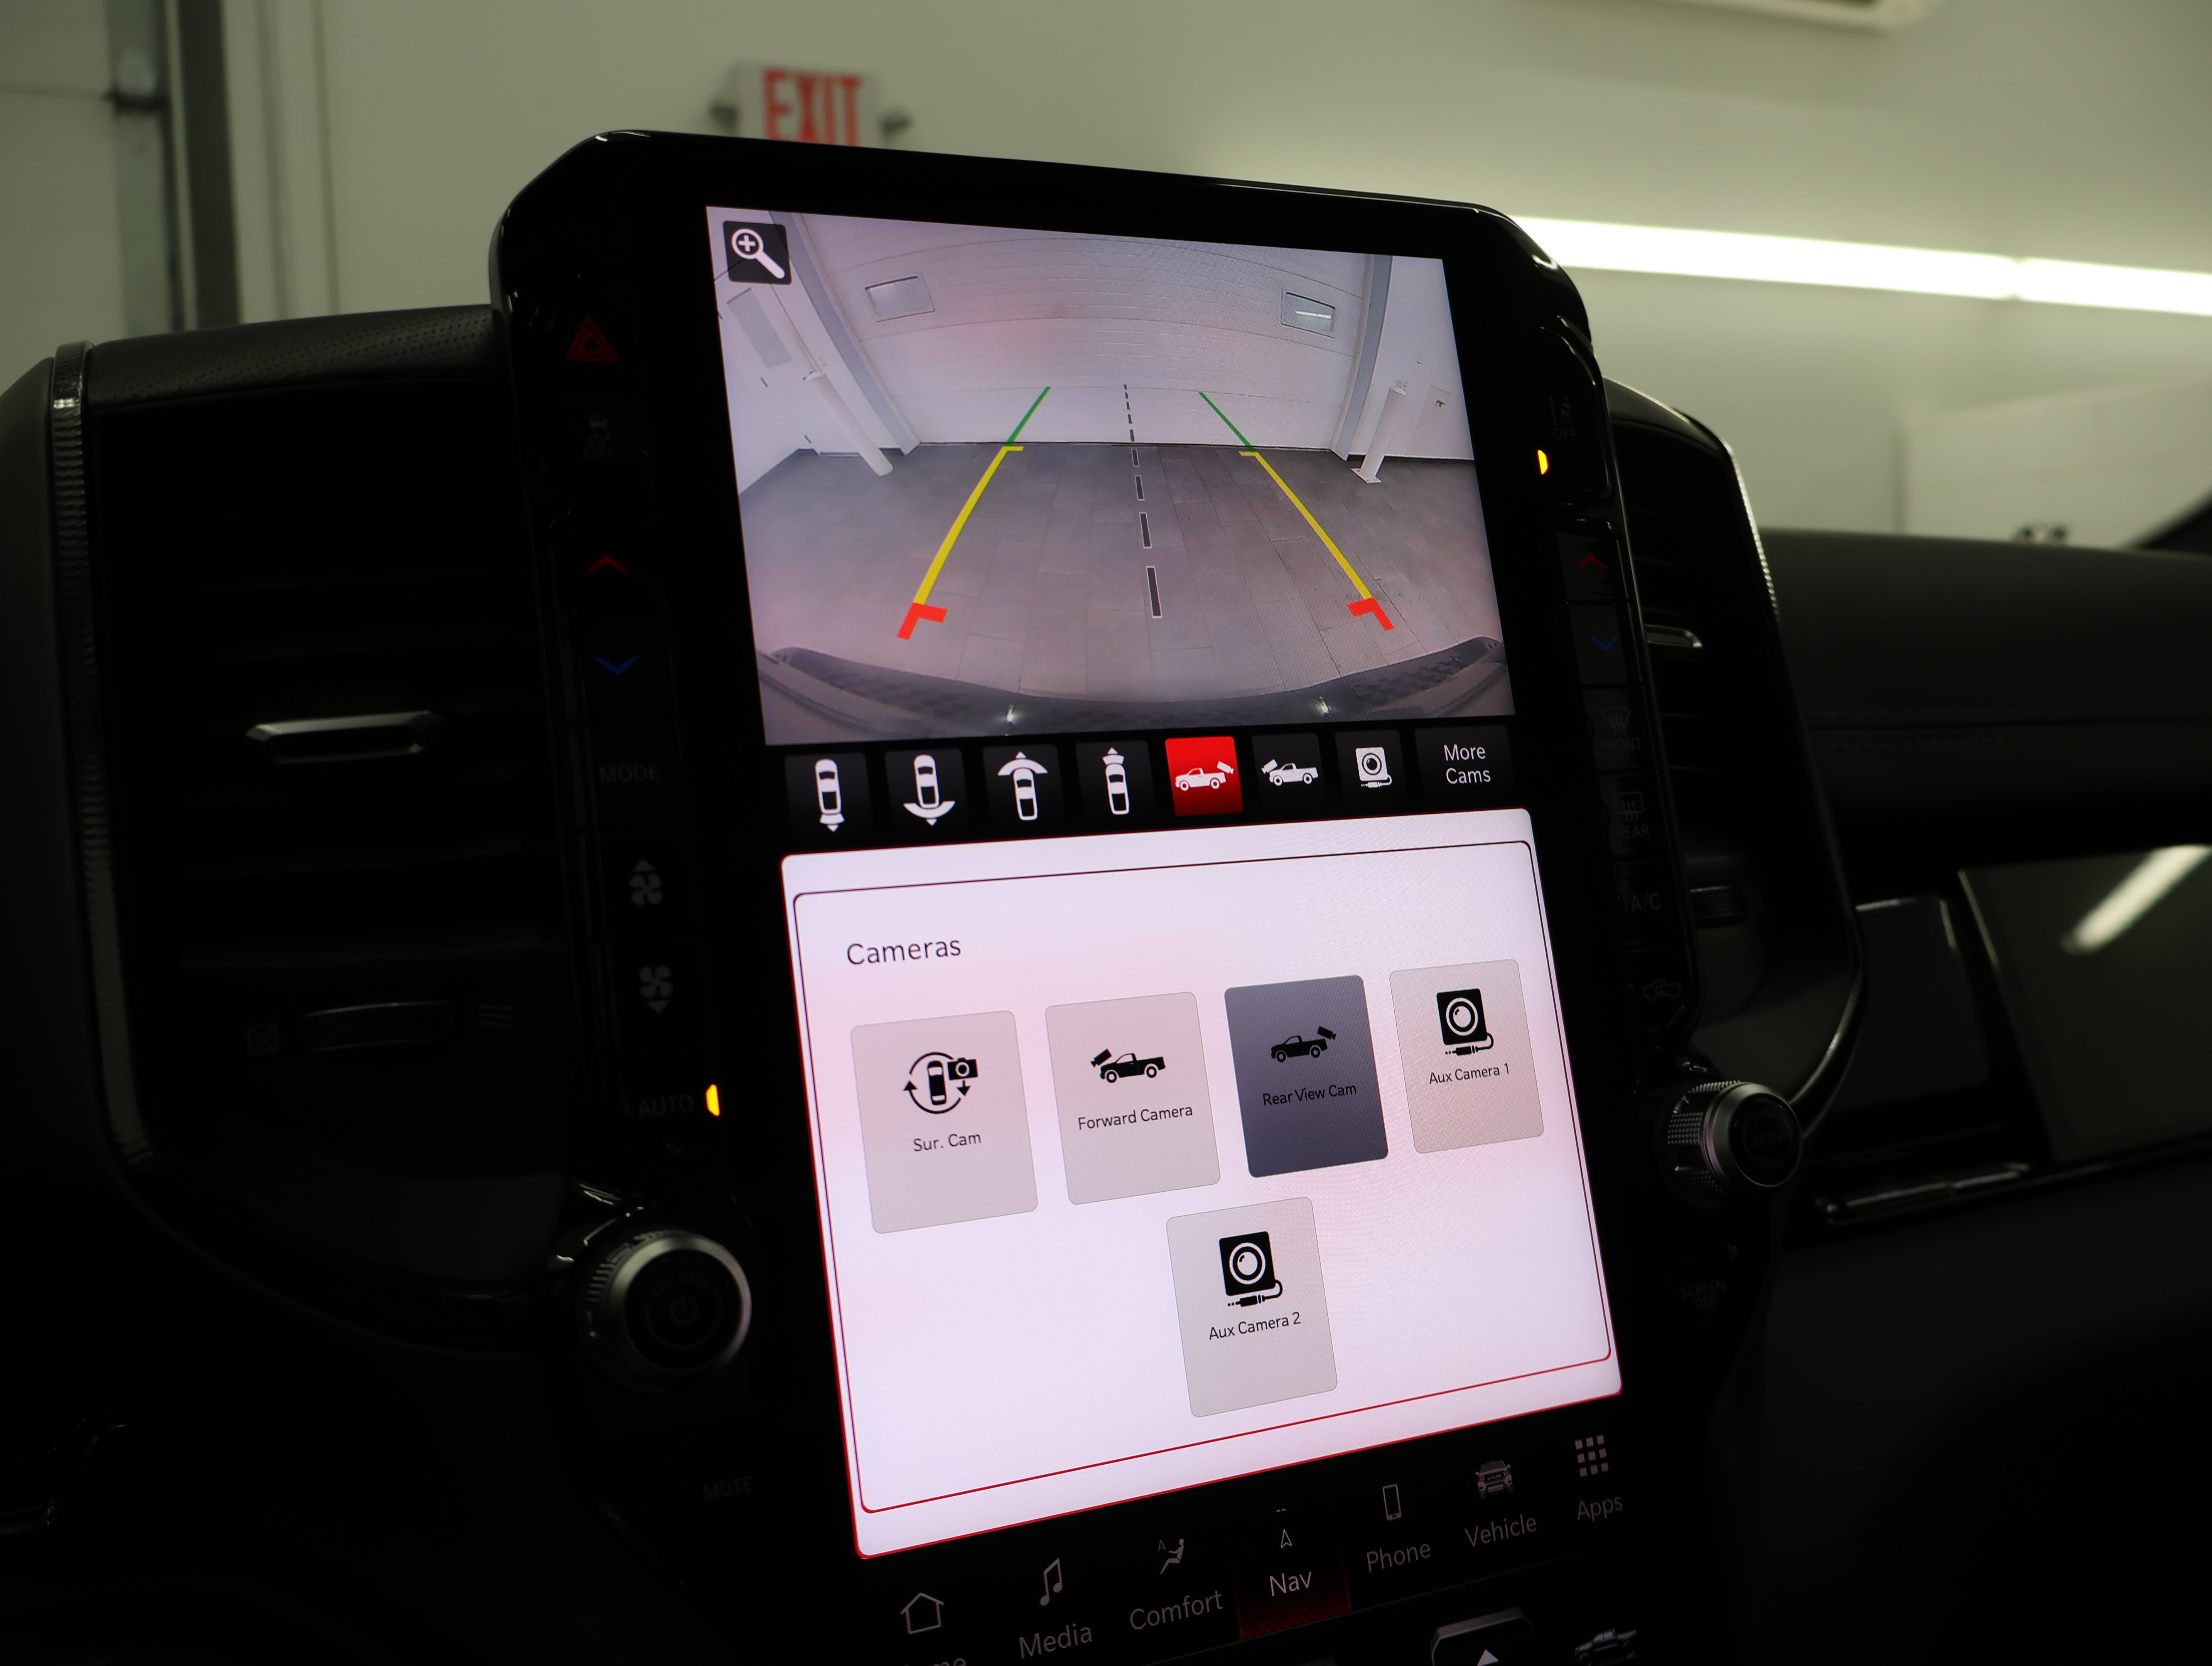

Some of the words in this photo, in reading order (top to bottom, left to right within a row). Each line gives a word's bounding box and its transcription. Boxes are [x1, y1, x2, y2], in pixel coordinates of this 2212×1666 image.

[763, 67, 862, 147] EXIT
[1552, 428, 1577, 441] OFF
[1443, 744, 1486, 761] More
[1600, 736, 1641, 752] FRONT
[599, 762, 660, 783] MODE
[1446, 767, 1492, 785] Cams
[1616, 824, 1650, 838] REAR
[1632, 892, 1662, 912] A/C
[847, 940, 961, 965] Cameras
[1429, 1072, 1453, 1084] Aux
[1454, 1067, 1500, 1081] Camera
[1503, 1062, 1509, 1074] 1
[638, 1093, 694, 1117] AUTO
[1262, 1093, 1292, 1106] Rear
[1294, 1087, 1325, 1102] View
[1328, 1084, 1357, 1097] Cam
[1078, 1110, 1137, 1130] Forward
[1140, 1106, 1193, 1122] Camera
[913, 1138, 944, 1152] Sur.
[948, 1133, 982, 1147] Cam
[1752, 1132, 1783, 1146] ENTER
[1680, 1278, 1726, 1299] SCREEN
[1694, 1295, 1715, 1310] OFF
[1209, 1326, 1235, 1341] Aux
[1238, 1317, 1289, 1335] Camera
[1292, 1311, 1301, 1325] 2
[702, 1475, 753, 1501] MUTE
[1577, 1496, 1623, 1523] Apps
[1464, 1514, 1537, 1547] Vehicle
[1366, 1541, 1431, 1573] Phone
[1269, 1571, 1312, 1597] Nav
[1130, 1590, 1223, 1630] Comfort
[1019, 1622, 1093, 1659] Media
